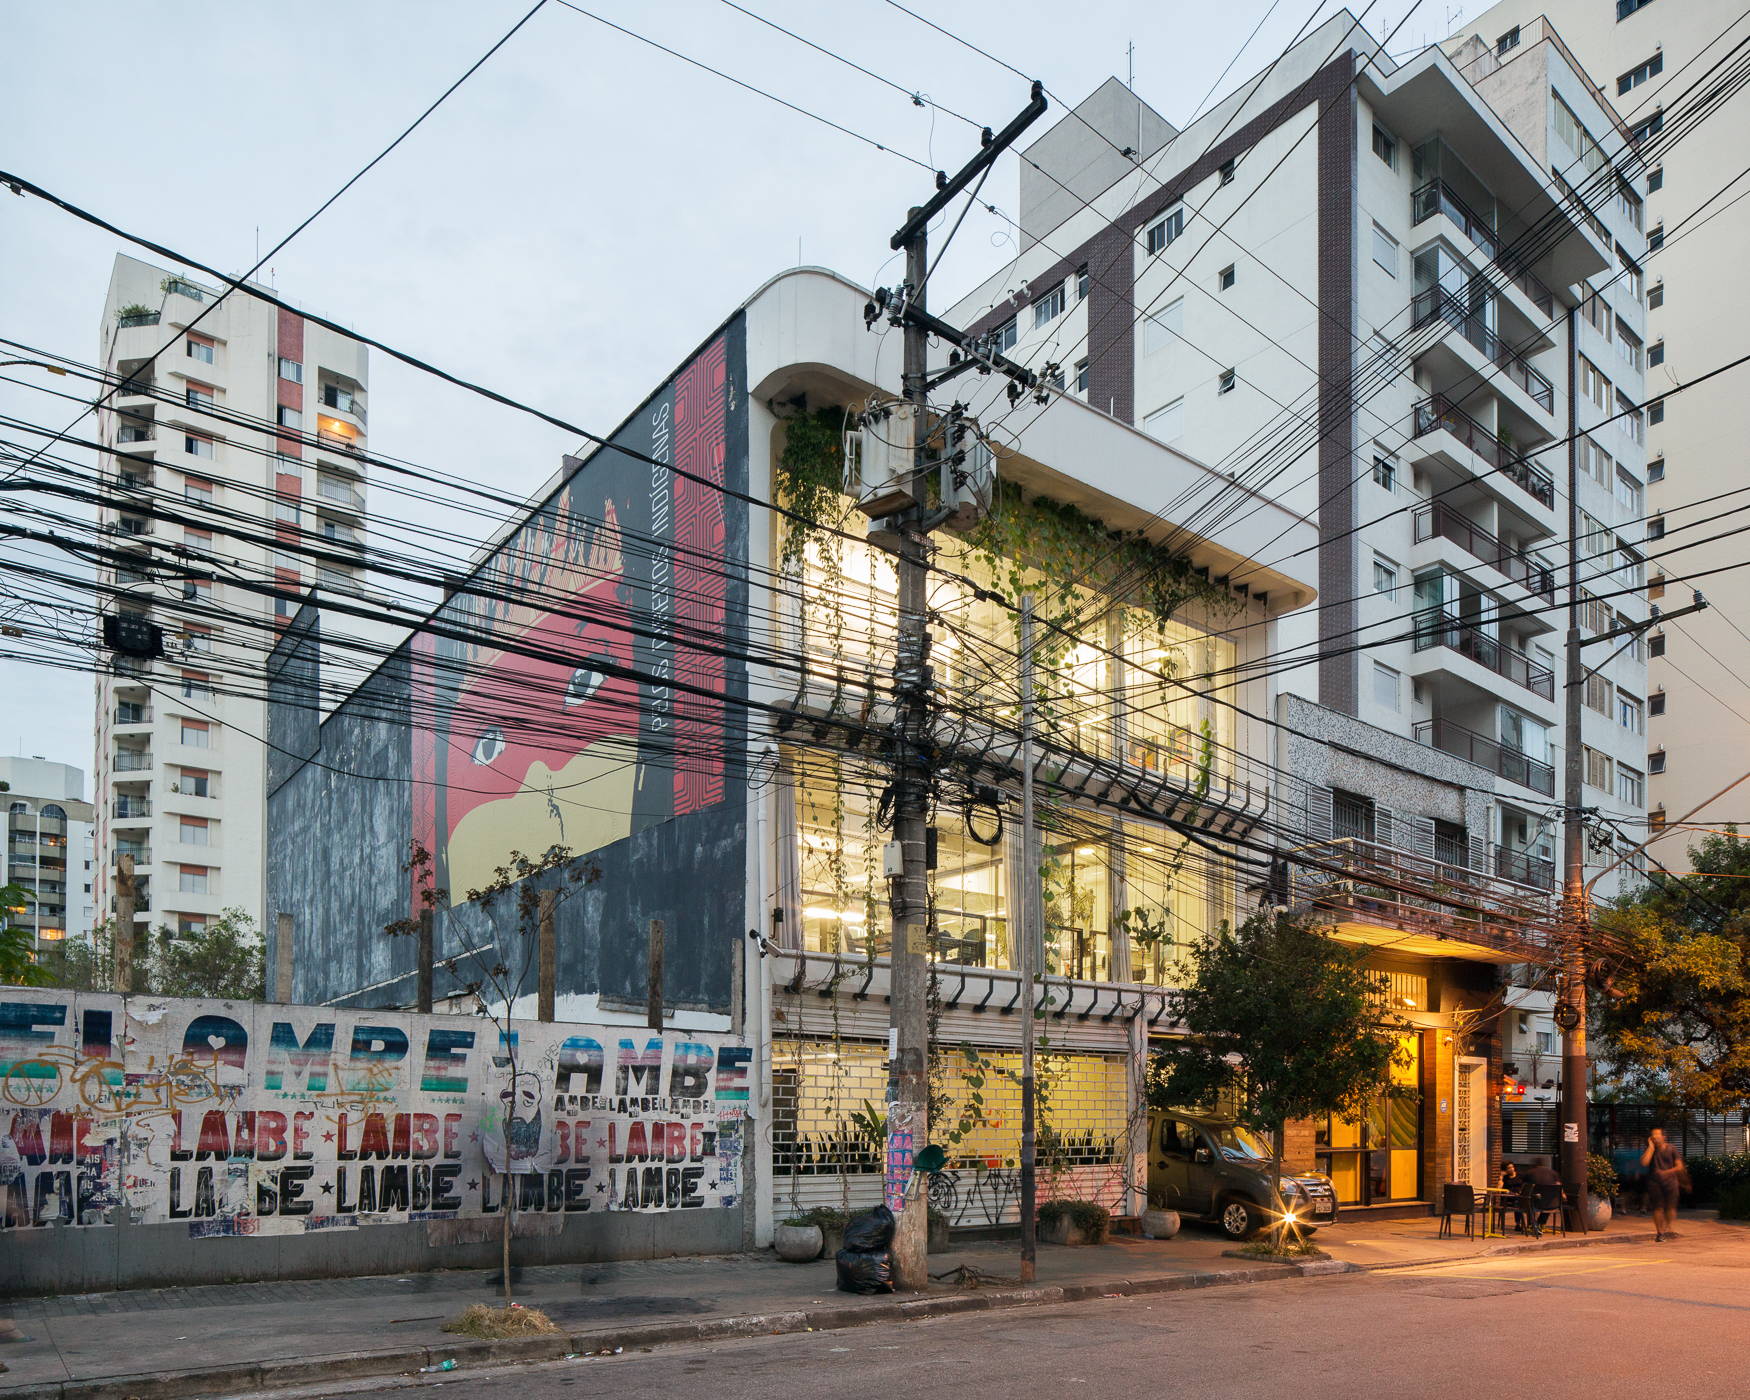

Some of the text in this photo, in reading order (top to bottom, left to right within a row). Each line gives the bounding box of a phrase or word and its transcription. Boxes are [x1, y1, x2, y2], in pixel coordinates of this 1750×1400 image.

[649, 402, 669, 538] INDÍGENAS
[652, 658, 669, 732] PELOS
[336, 1112, 463, 1161] LAMBE
[608, 1121, 705, 1164] LAMBE
[336, 1163, 463, 1213] LAMBE
